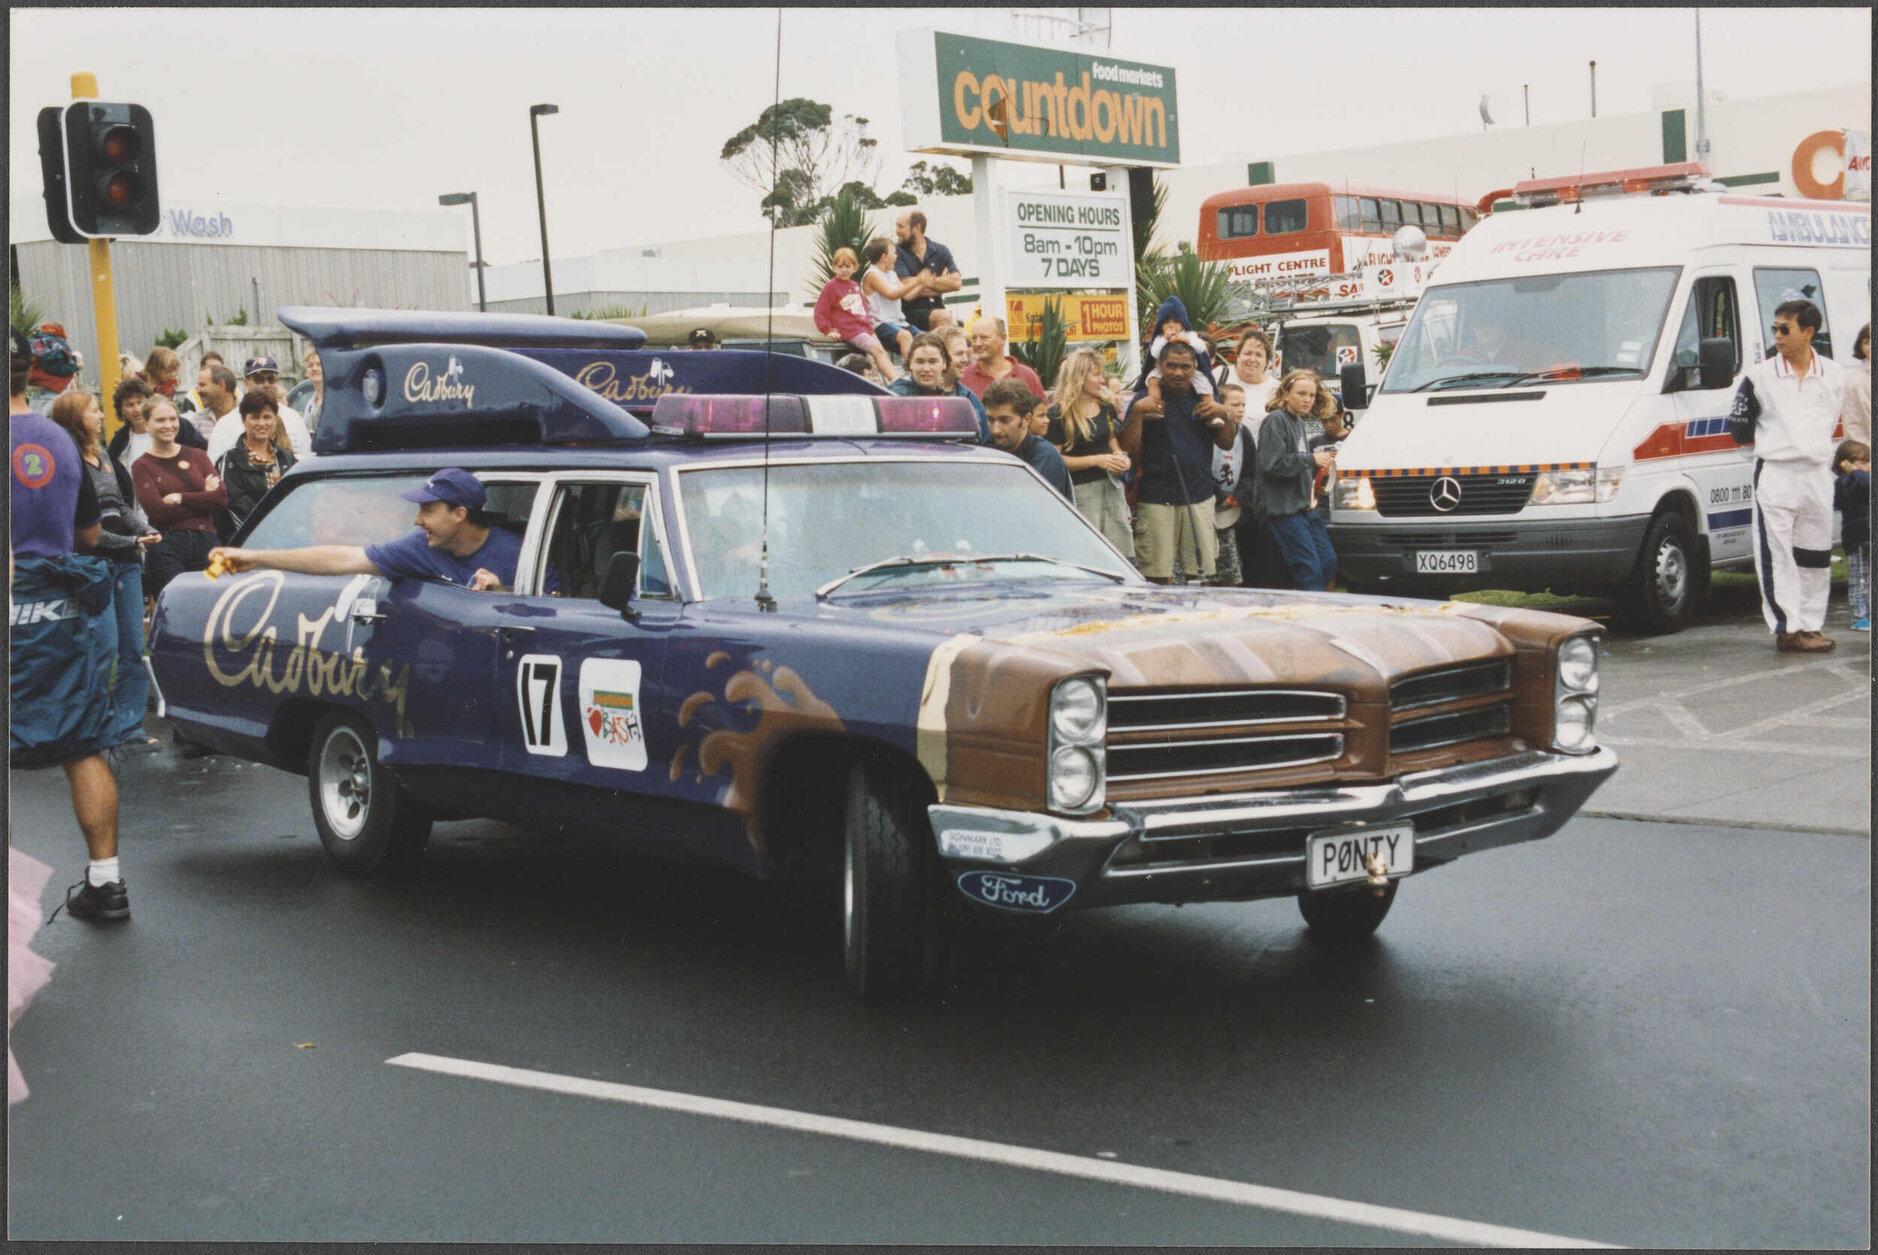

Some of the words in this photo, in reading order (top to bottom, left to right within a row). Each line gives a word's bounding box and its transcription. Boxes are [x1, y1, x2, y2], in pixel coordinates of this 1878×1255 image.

[1092, 61, 1118, 81] food
[1119, 67, 1164, 88] markets
[954, 70, 1167, 148] countdown
[169, 208, 233, 236] Wash
[1017, 202, 1075, 223] OPENING
[1078, 206, 1120, 226] HOURS
[1024, 233, 1061, 254] 8am
[1074, 235, 1118, 258] 10pm
[1489, 229, 1633, 254] INTENSIVE
[1514, 245, 1582, 262] CARE
[1041, 258, 1053, 278] 7
[1057, 258, 1101, 278] DAYS
[1277, 257, 1327, 272] CENTRE
[1082, 303, 1092, 333] 1
[1092, 302, 1123, 319] HOUR
[1093, 321, 1125, 333] PHOTOS
[404, 361, 476, 409] Cadbury
[24, 453, 43, 476] 2
[1711, 487, 1729, 503] 0800
[1419, 554, 1475, 570] XQ6498
[204, 569, 411, 739] Cadbury
[521, 662, 558, 747] 17
[981, 874, 1050, 907] Ford
